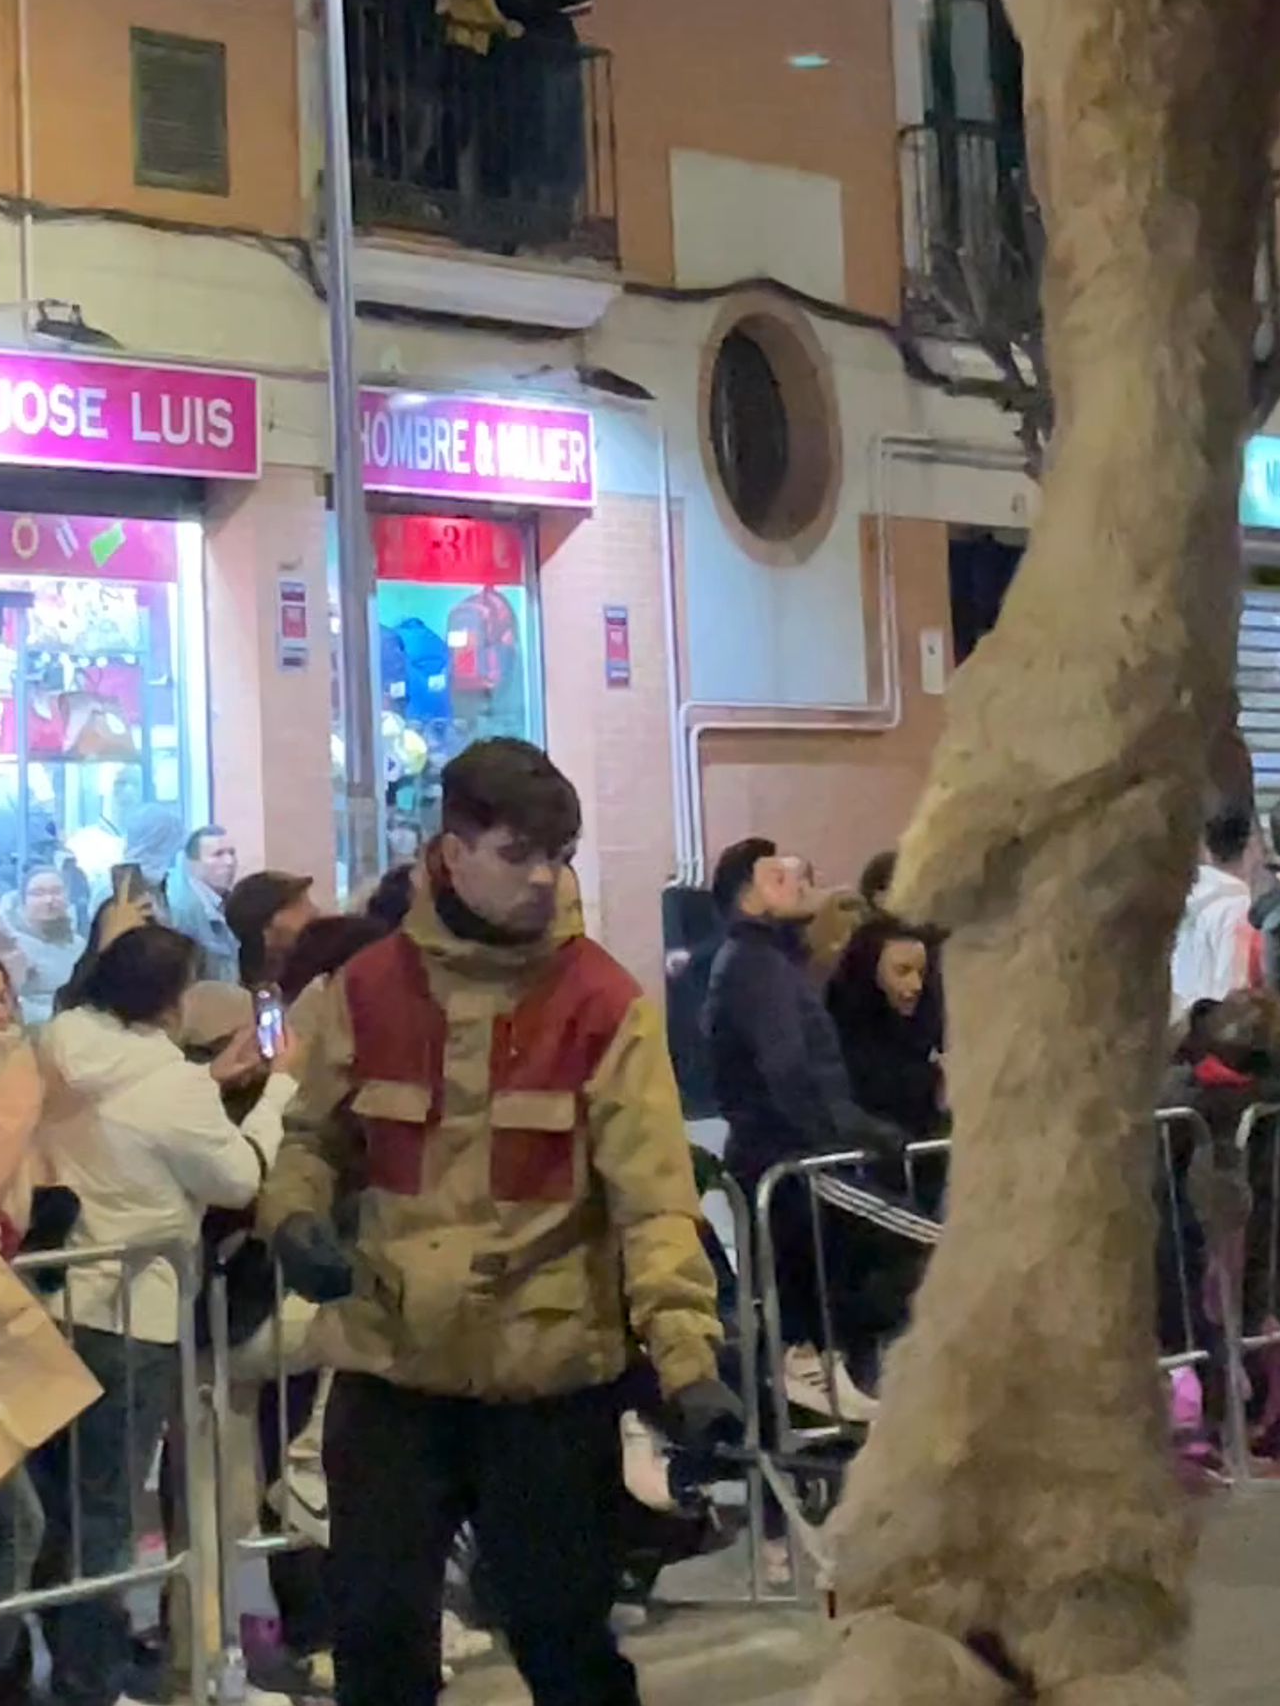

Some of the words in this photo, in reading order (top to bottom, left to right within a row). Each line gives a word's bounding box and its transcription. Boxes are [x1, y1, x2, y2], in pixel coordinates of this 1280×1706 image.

[131, 391, 235, 447] LUIS
[474, 420, 496, 477] &
[496, 422, 589, 484] MUJER
